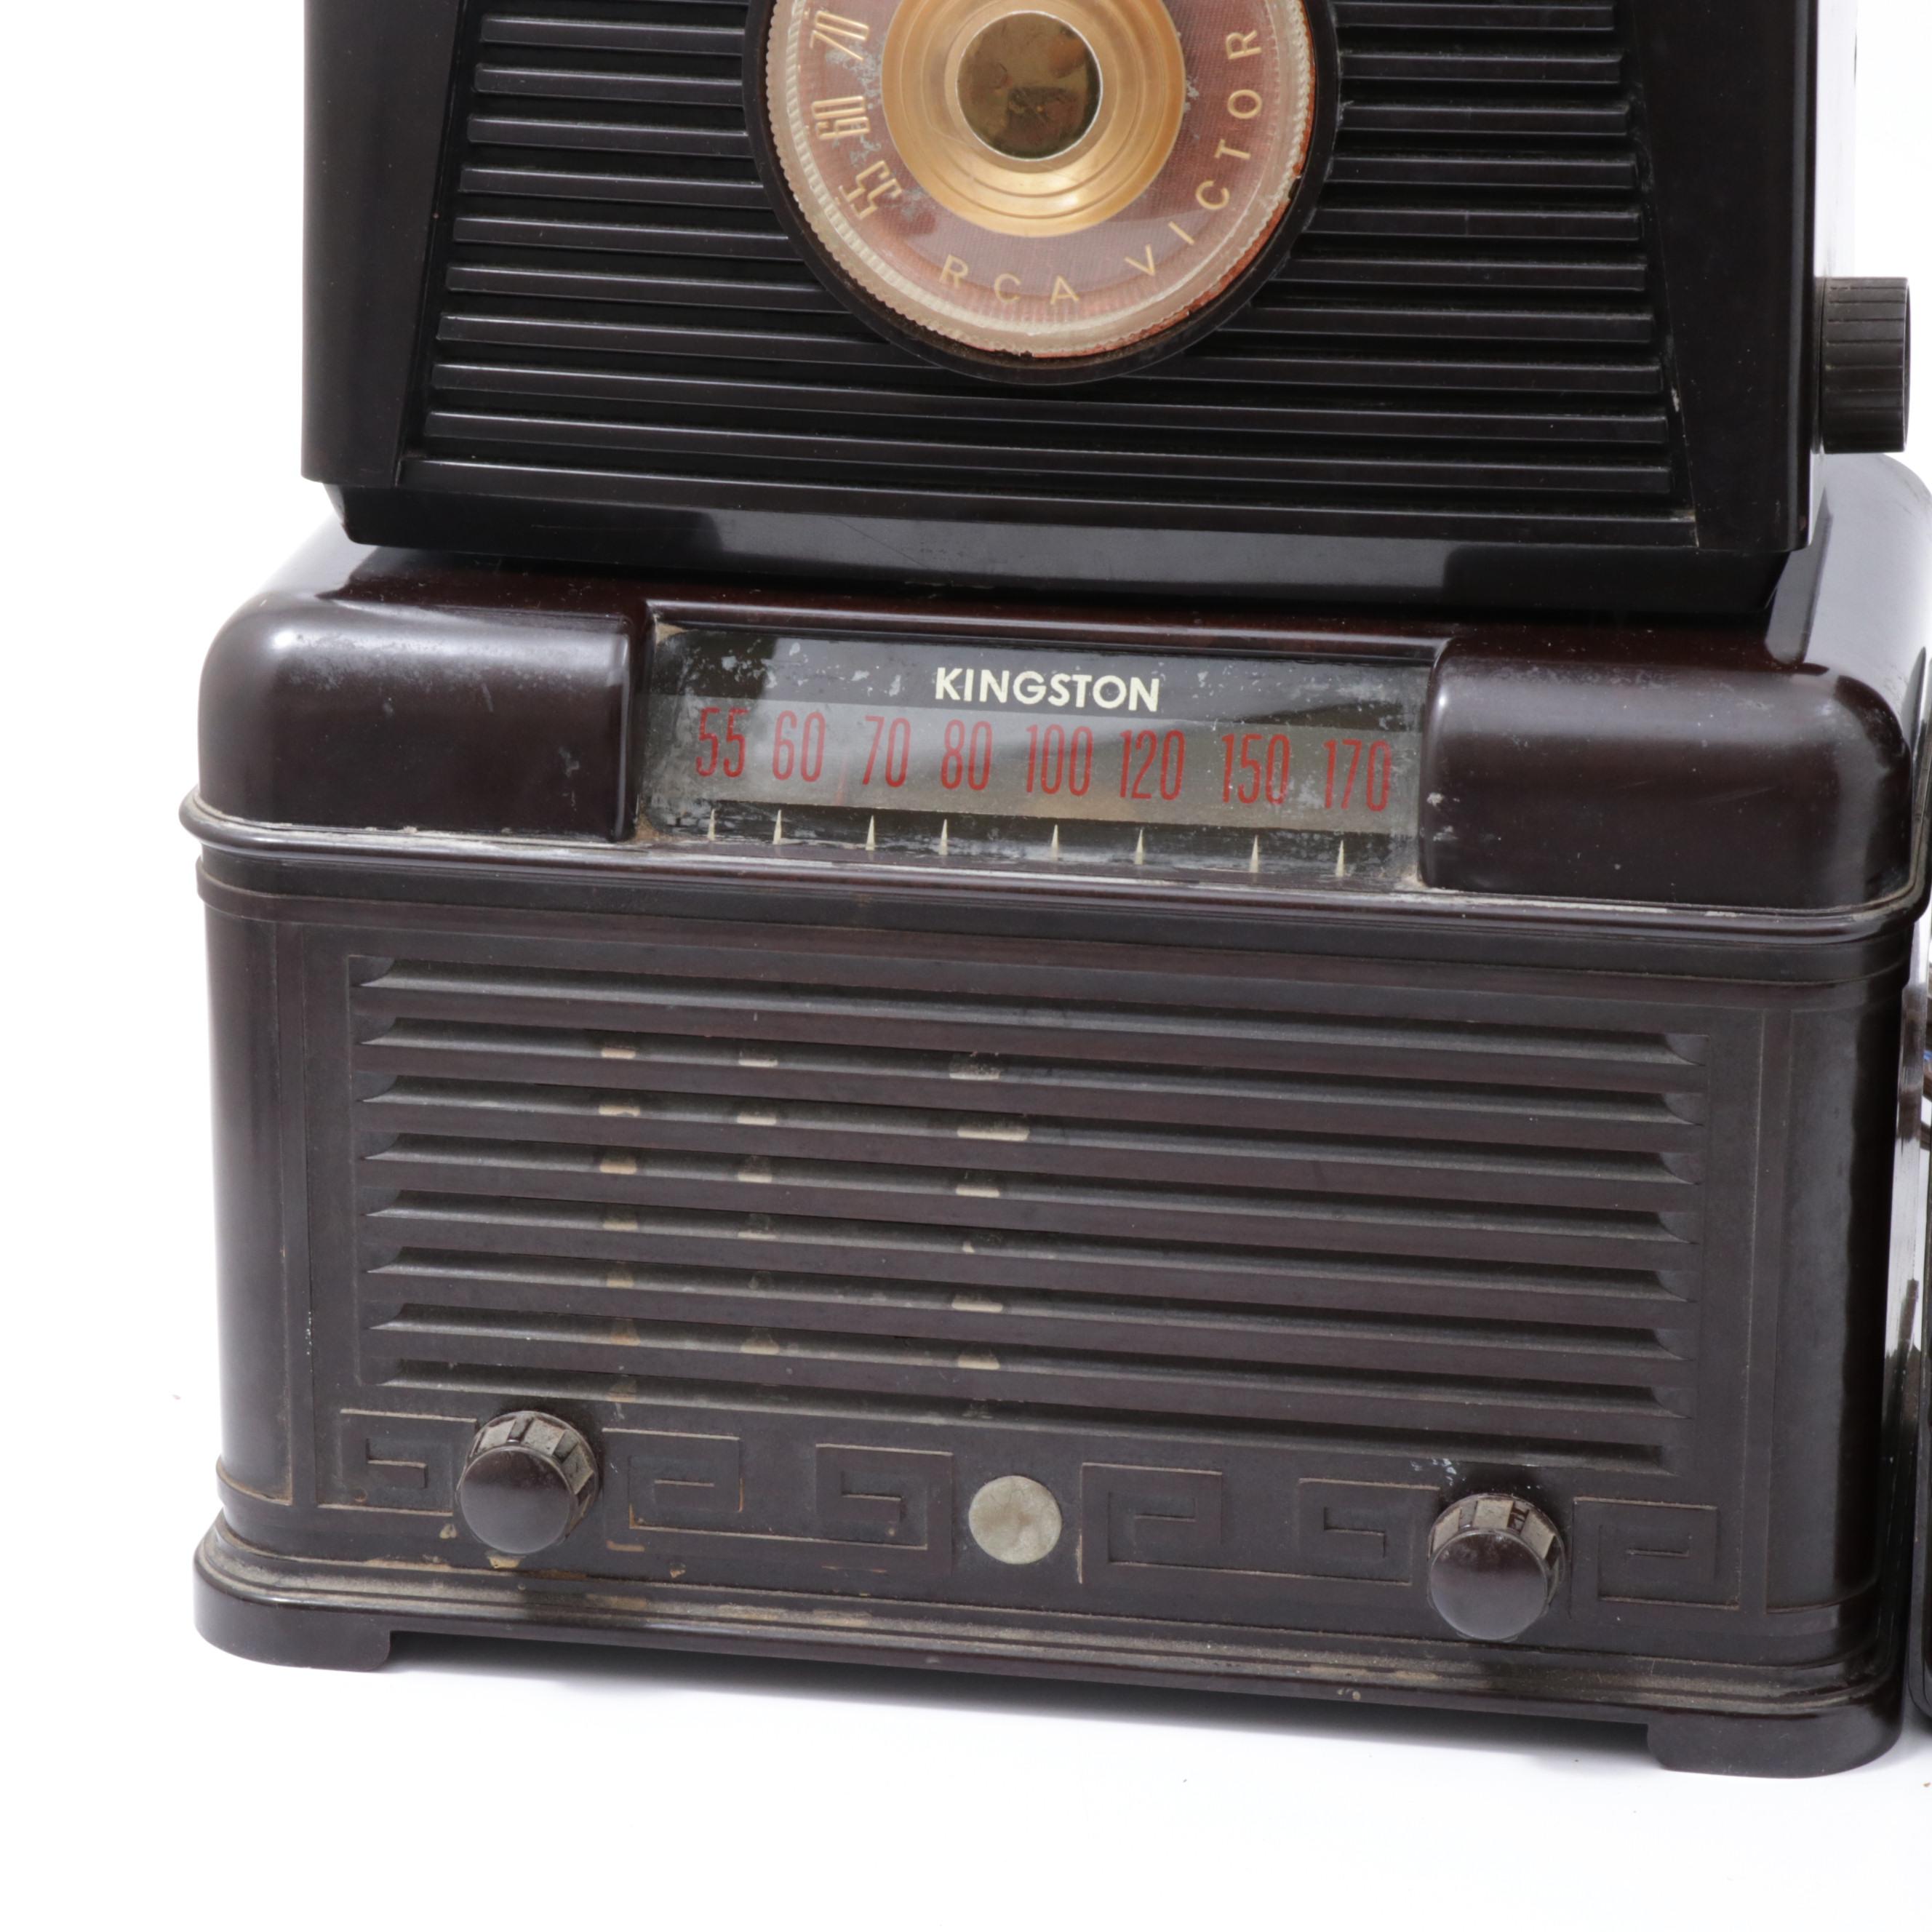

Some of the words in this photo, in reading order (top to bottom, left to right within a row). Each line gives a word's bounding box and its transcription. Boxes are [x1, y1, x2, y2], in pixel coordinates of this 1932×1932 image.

[809, 10, 869, 61] 70
[811, 95, 871, 140] 60
[839, 160, 903, 219] 55
[938, 254, 1079, 306] RCA
[1125, 29, 1263, 278] VICTOR
[935, 667, 1160, 712] KINGSTON
[695, 707, 748, 778] 55
[772, 710, 826, 783] 60
[861, 715, 911, 788] 70
[940, 719, 993, 791] 80
[1026, 724, 1093, 797] 100
[1119, 729, 1186, 800] 120
[1221, 733, 1291, 805] 150
[1323, 738, 1392, 812] 170
